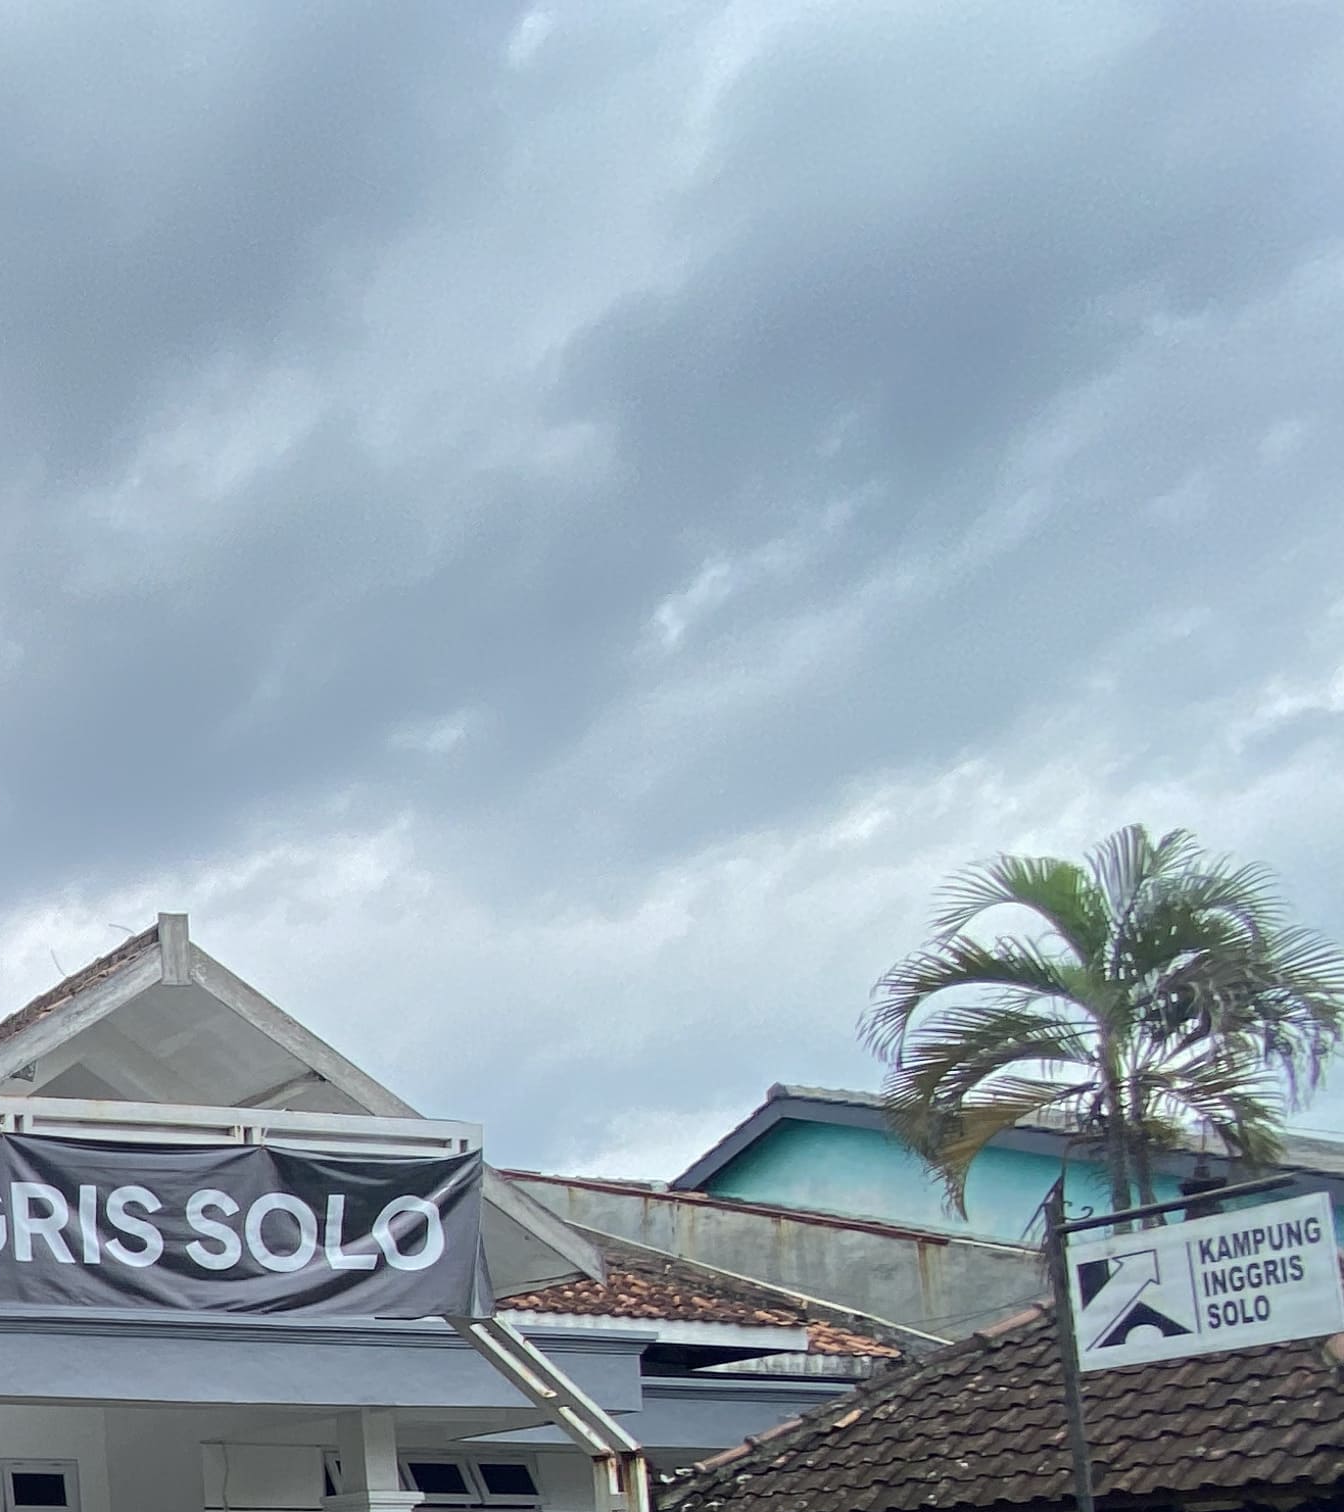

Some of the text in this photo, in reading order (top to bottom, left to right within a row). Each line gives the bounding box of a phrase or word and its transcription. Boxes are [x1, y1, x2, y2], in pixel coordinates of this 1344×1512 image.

[185, 1189, 445, 1273] SOLO
[1198, 1217, 1321, 1264] KAMPUNG
[1203, 1255, 1304, 1297] INGGRIS
[1207, 1295, 1270, 1329] SOLO
